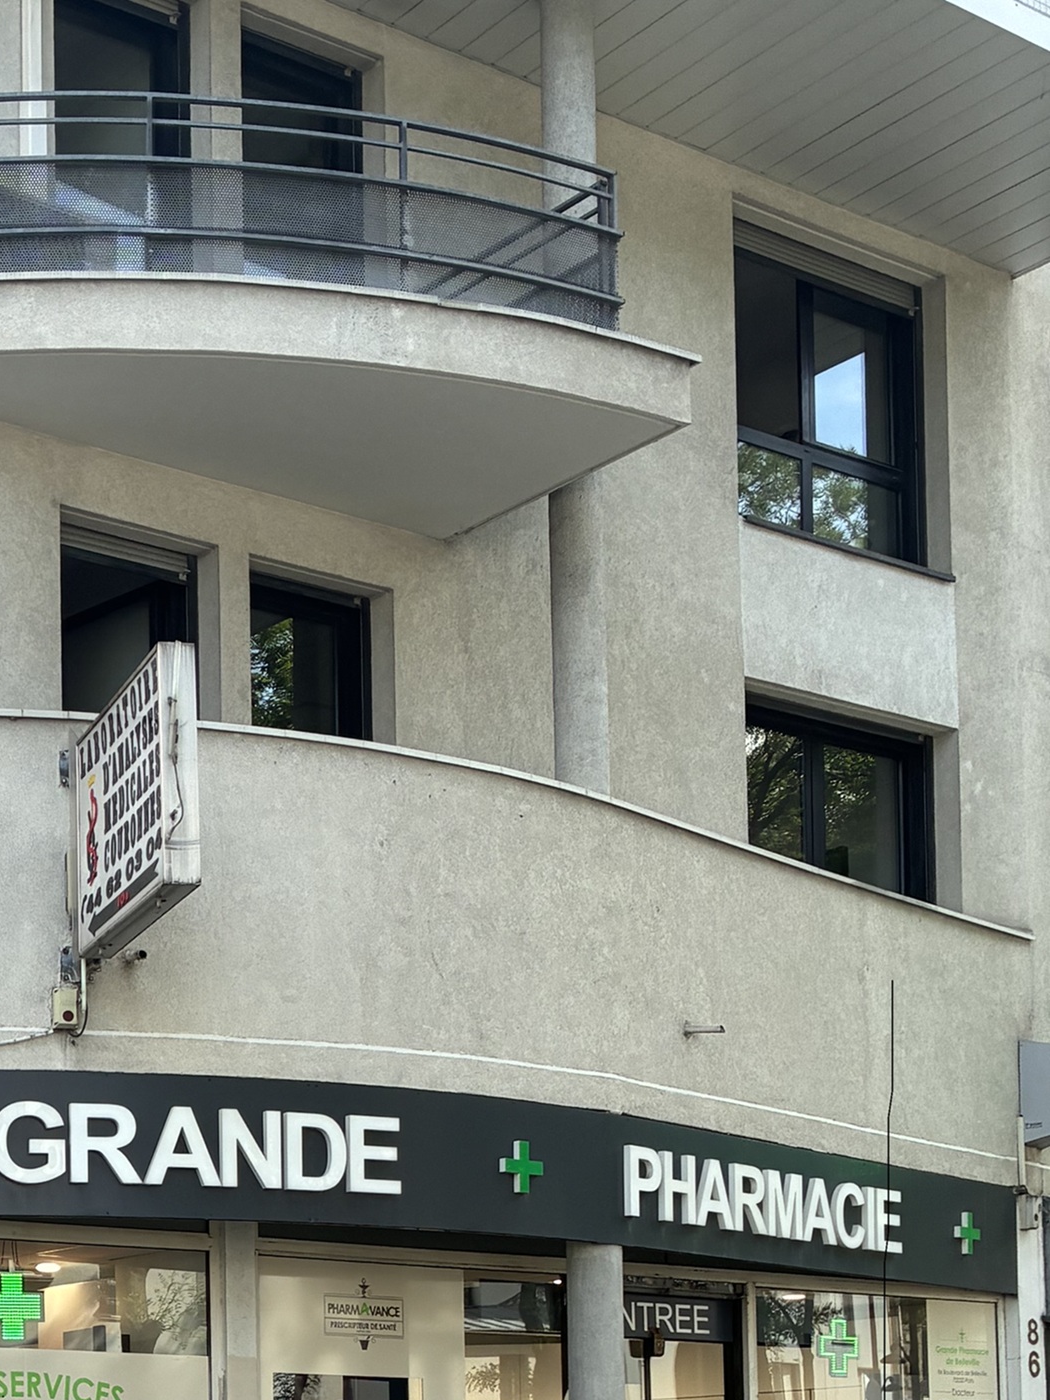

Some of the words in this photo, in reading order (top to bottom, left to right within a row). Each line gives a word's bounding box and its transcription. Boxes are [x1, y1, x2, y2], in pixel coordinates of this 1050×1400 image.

[79, 656, 158, 780] LABORATOIRE
[102, 700, 160, 796] D'ANALYSES
[103, 742, 162, 835] MEDICALES
[104, 784, 163, 873] COURONNES
[105, 868, 122, 900] 62
[125, 848, 143, 882] 03
[145, 826, 163, 861] 04
[623, 1144, 903, 1254] PHARMACIE
[623, 1301, 711, 1335] NTREE
